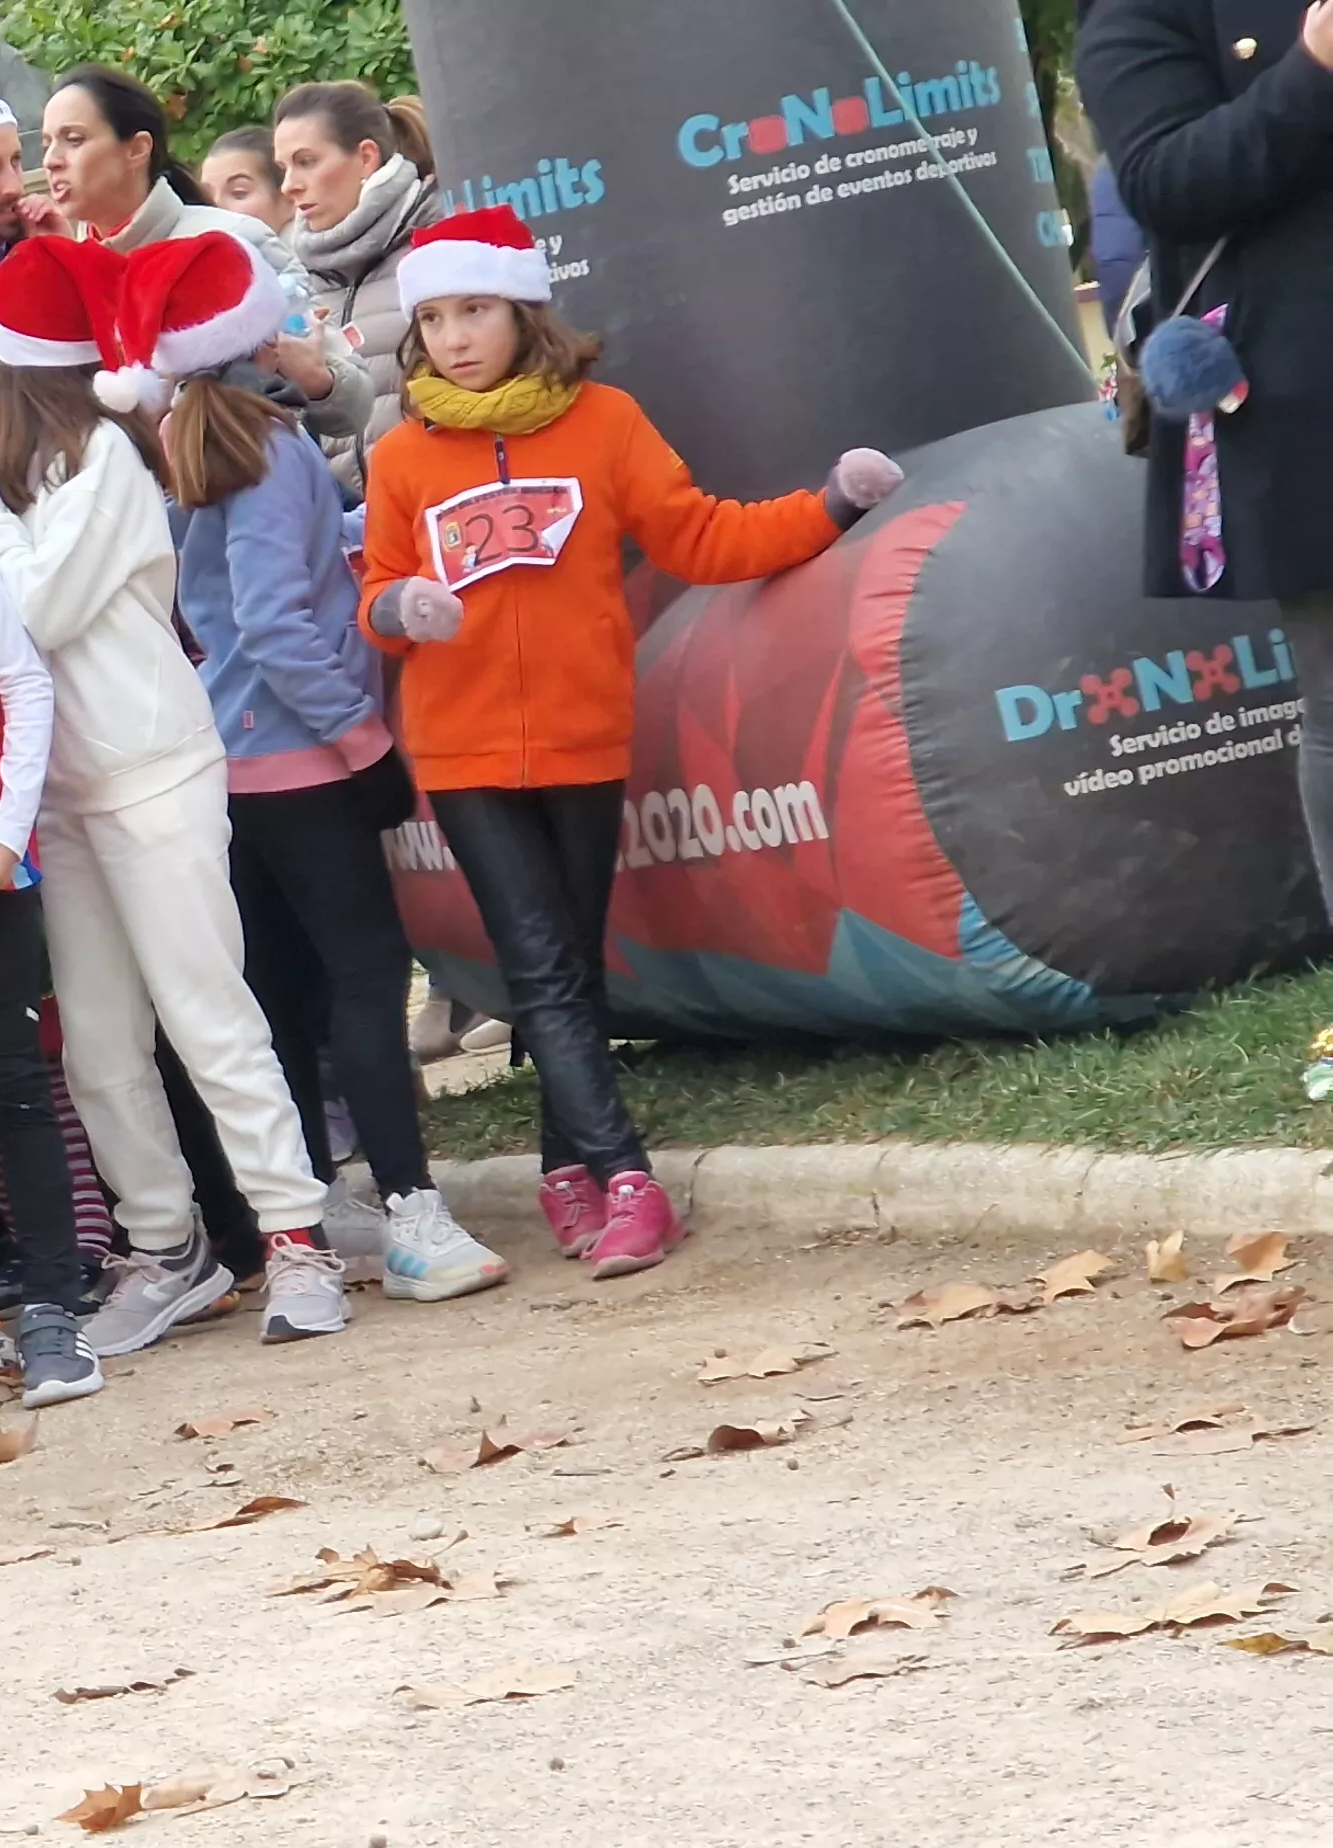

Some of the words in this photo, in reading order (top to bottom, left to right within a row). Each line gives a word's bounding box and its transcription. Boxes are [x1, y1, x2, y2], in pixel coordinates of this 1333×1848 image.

[727, 161, 811, 196] Servicio
[815, 151, 842, 174] de
[845, 127, 967, 169] cronomeraje
[966, 125, 979, 146] y
[722, 189, 803, 228] gestión
[805, 181, 834, 206] de
[837, 166, 913, 200] eventos
[465, 504, 539, 566] 23
[1063, 766, 1134, 797] vídeo
[1137, 728, 1284, 786] promocional
[1108, 721, 1202, 758] Servicio
[1205, 710, 1237, 735] de
